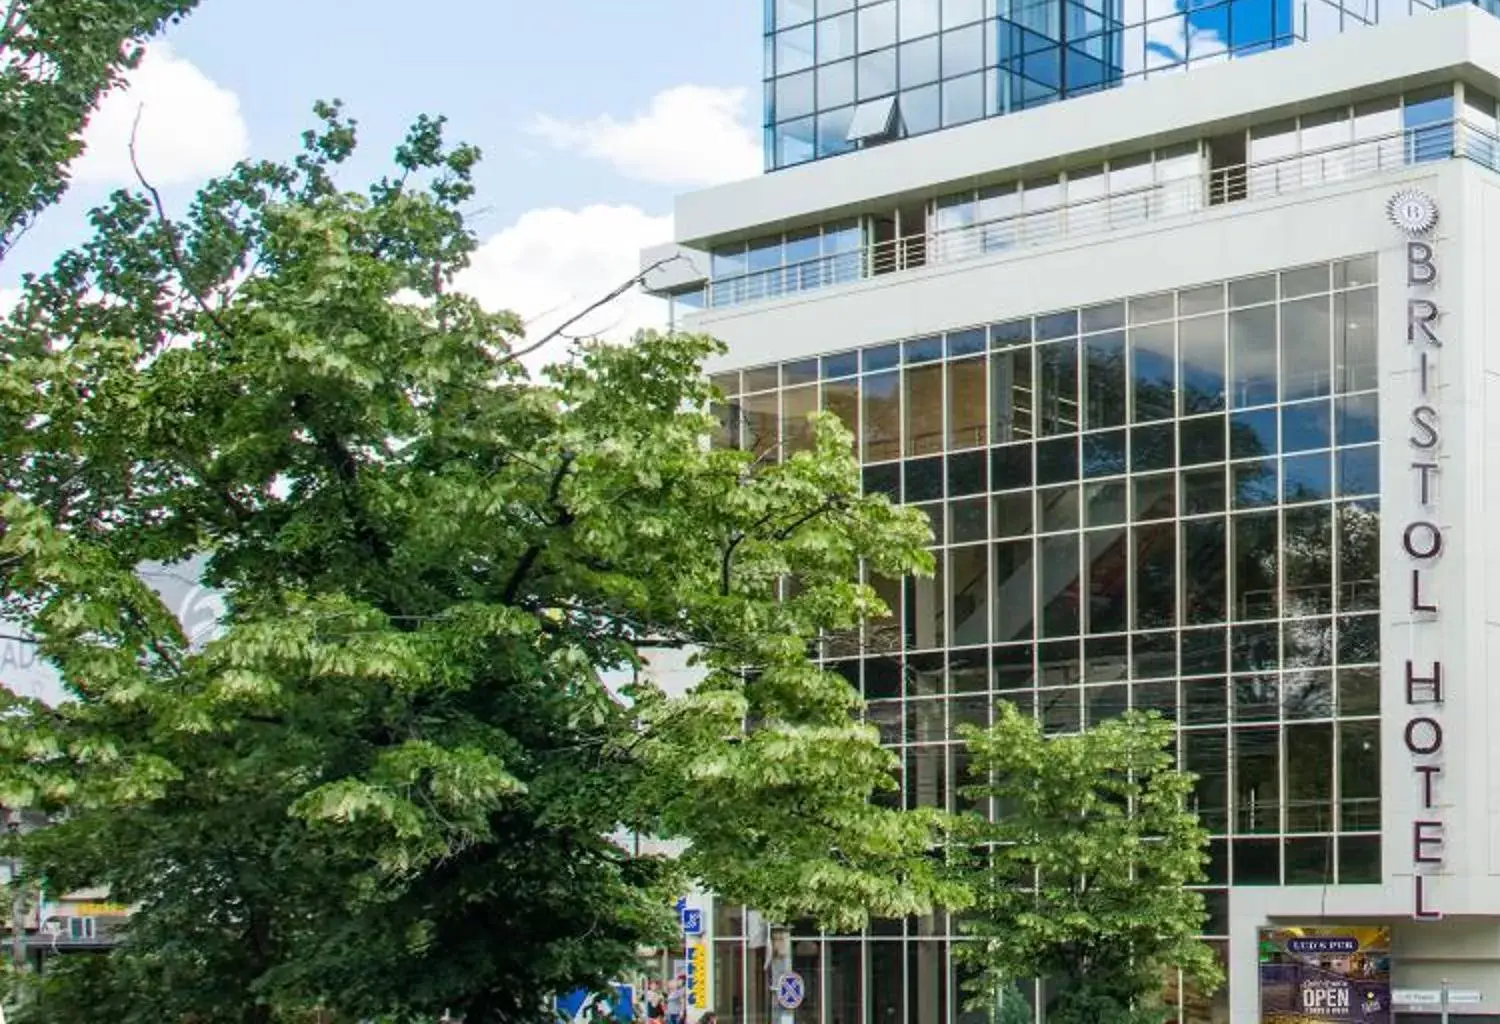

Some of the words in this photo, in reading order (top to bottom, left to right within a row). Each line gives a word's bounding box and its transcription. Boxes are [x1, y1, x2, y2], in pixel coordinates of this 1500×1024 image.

[1404, 241, 1442, 613] BRISTOL
[1404, 660, 1442, 917] HOTEL
[1303, 988, 1350, 1007] OPEN
